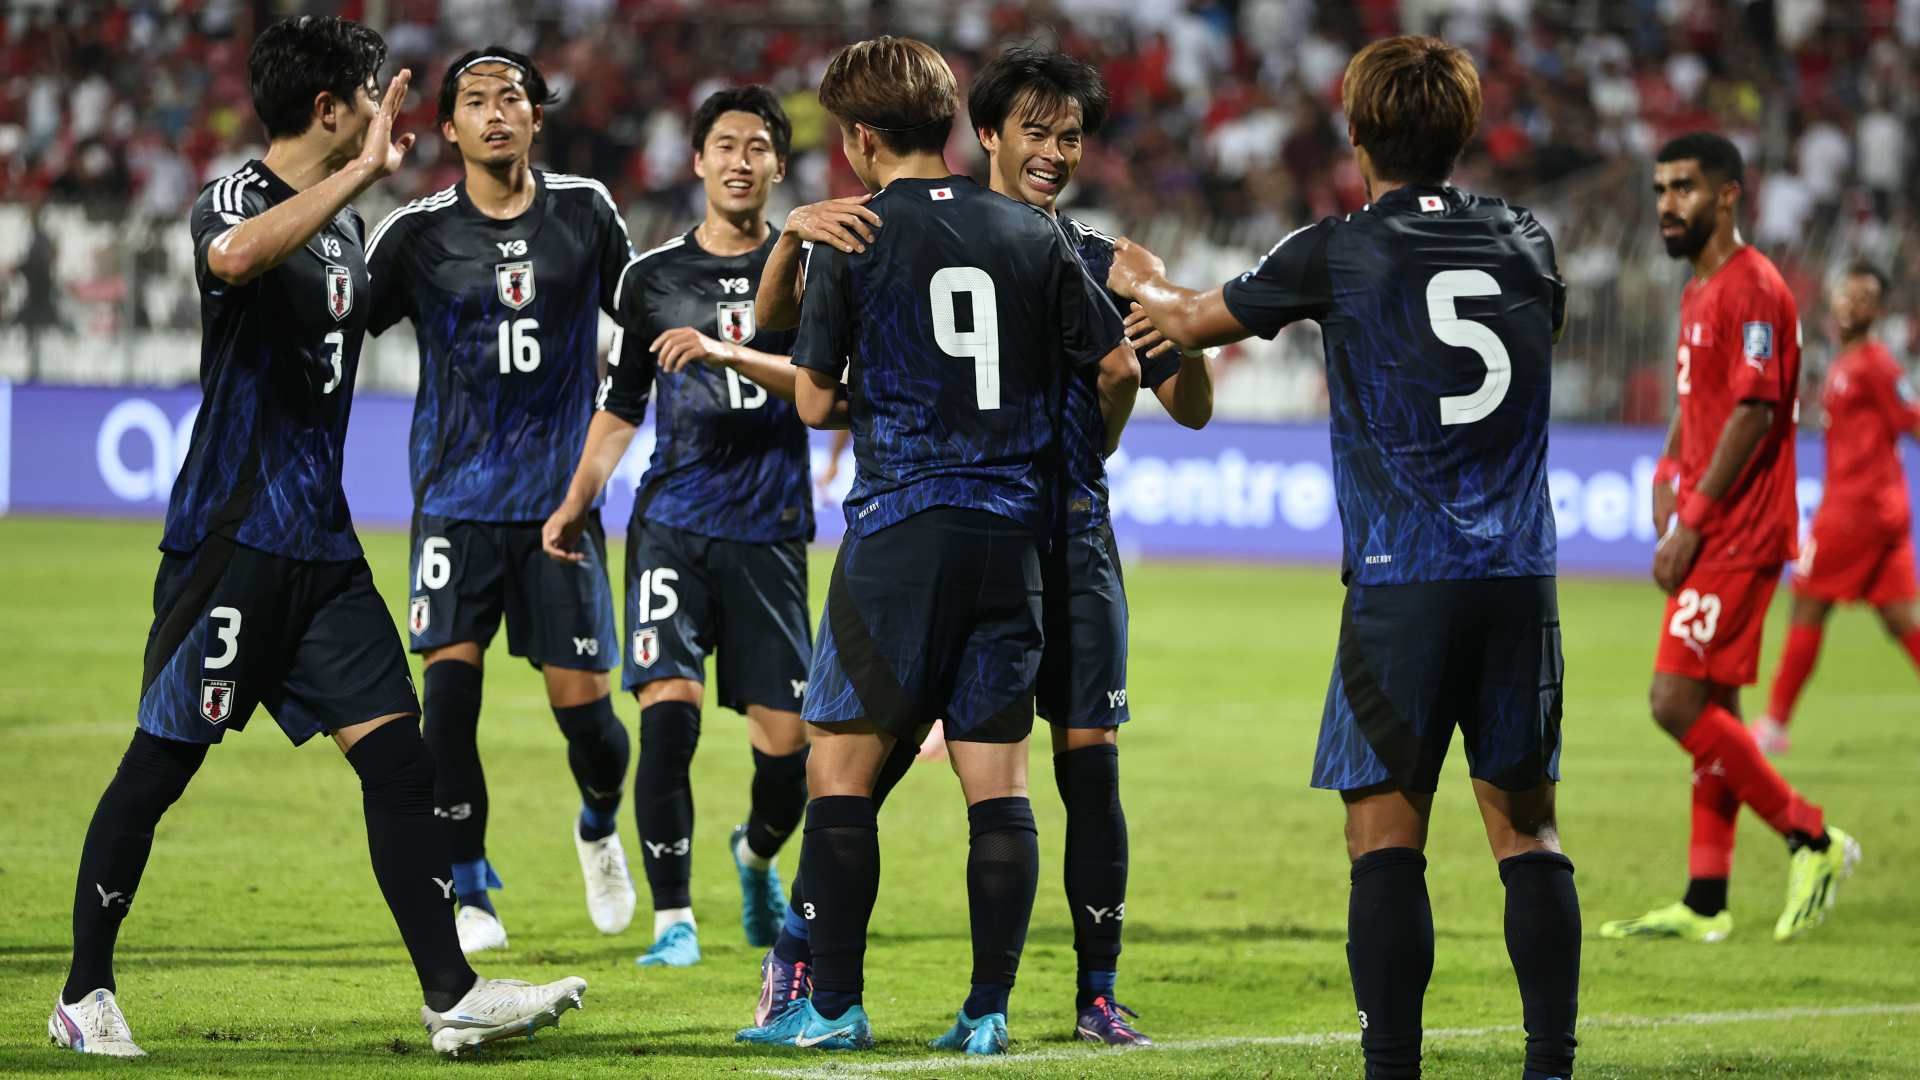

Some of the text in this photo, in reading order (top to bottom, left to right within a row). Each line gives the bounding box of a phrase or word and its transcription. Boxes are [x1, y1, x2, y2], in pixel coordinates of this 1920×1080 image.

[321, 237, 341, 257] Y-3
[496, 240, 528, 257] Y-3
[718, 277, 750, 294] Y-3
[323, 332, 344, 394] 3
[498, 317, 541, 374] 16
[929, 267, 1001, 411] 9
[1426, 270, 1513, 426] 5
[416, 536, 451, 592] 16
[639, 567, 680, 624] 15
[1669, 588, 1721, 644] 23
[204, 606, 242, 670] 3
[572, 636, 599, 656] Y-3
[1107, 688, 1126, 709] Y-3
[645, 838, 690, 859] Y-3
[1085, 901, 1126, 924] Y-3
